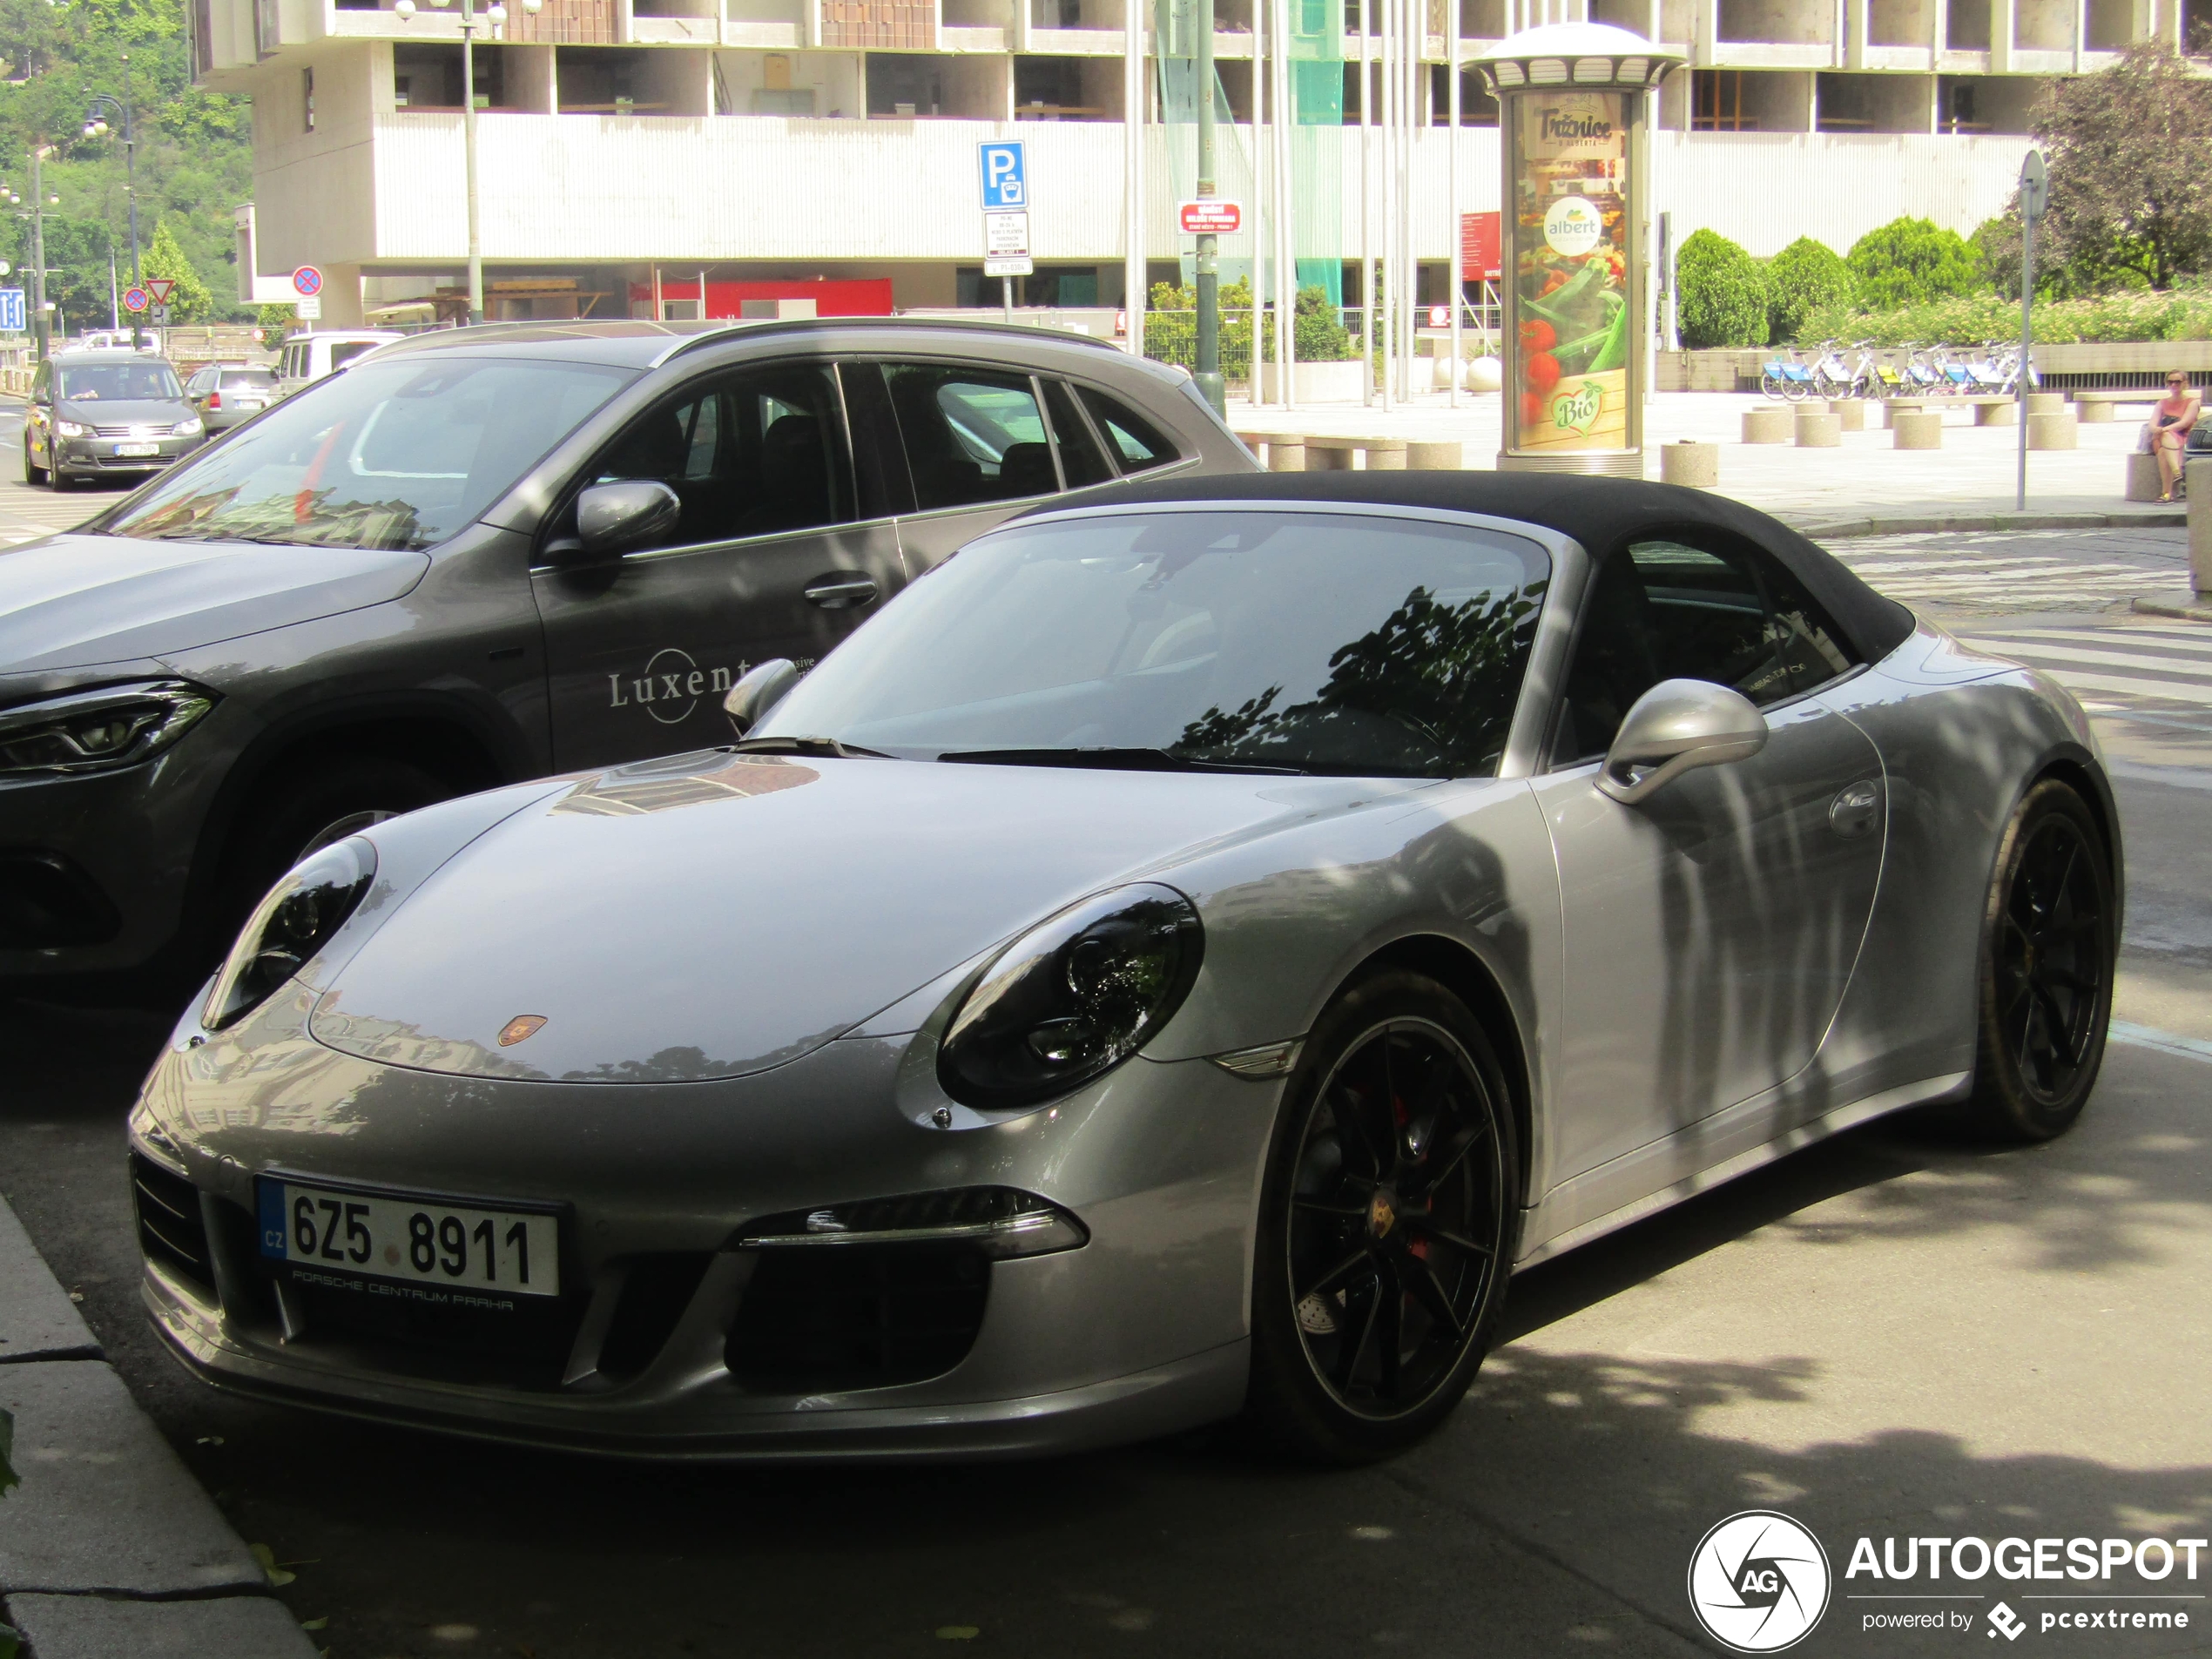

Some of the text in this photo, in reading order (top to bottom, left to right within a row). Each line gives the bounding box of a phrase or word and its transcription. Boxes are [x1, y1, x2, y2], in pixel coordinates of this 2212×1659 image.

[1541, 108, 1612, 139] Tržnice
[988, 149, 1015, 188] P
[1549, 219, 1595, 234] albert
[1557, 400, 1596, 428] Bio
[265, 1229, 284, 1249] CZ
[293, 1196, 530, 1285] 6Z5 8911
[292, 1270, 515, 1311] PORSCHE CENTRUM PRAHA
